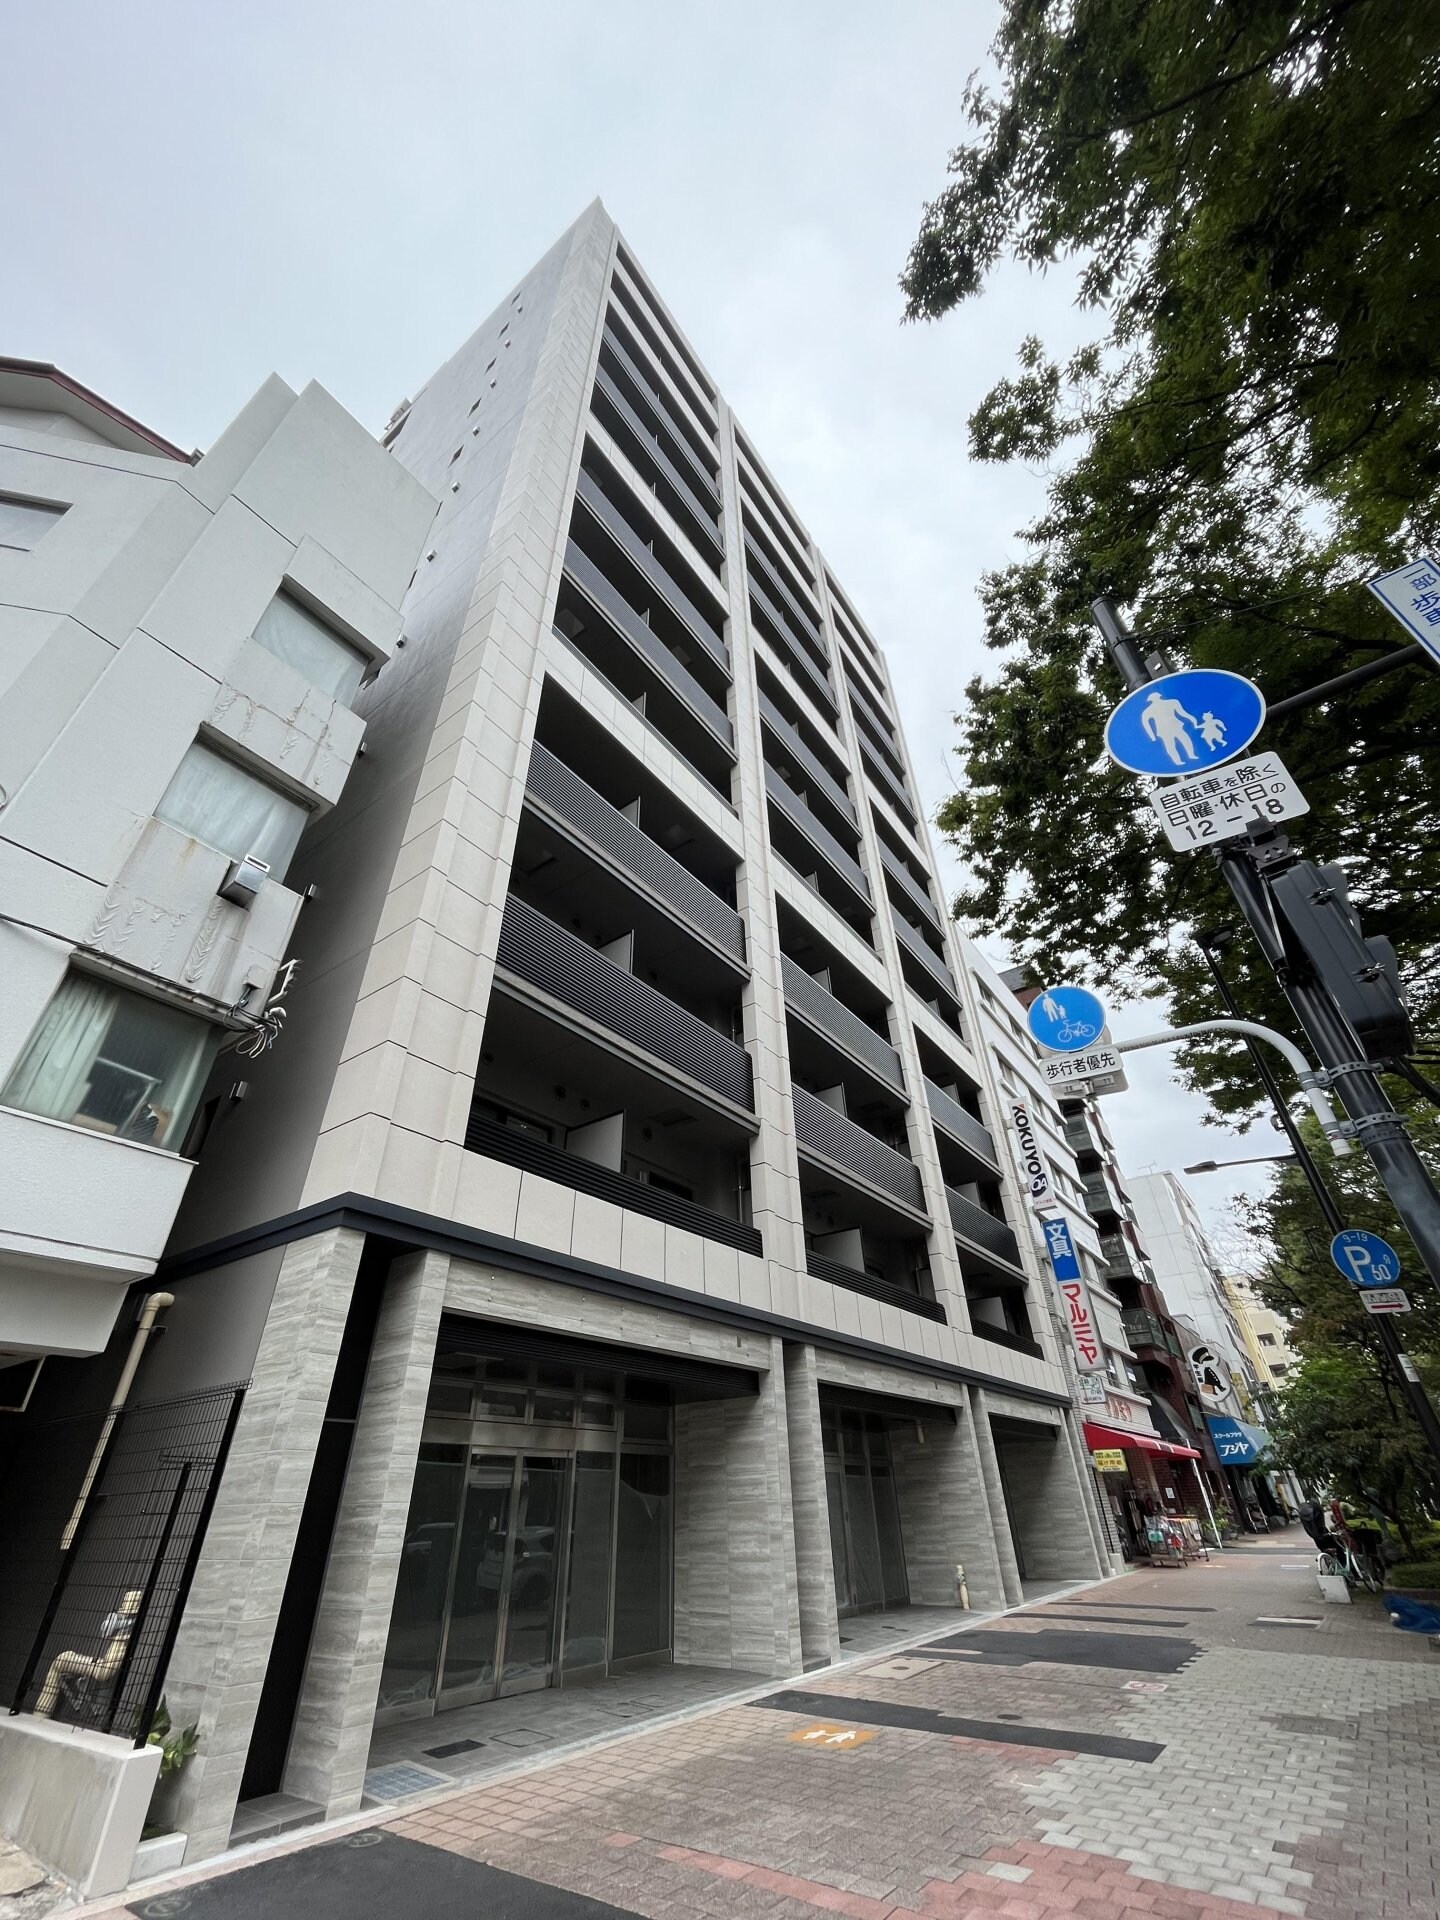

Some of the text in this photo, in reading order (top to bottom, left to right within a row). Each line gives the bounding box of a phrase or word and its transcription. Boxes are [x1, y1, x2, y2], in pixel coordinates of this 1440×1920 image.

[1159, 763, 1279, 809] 自転車を除く
[1046, 1052, 1116, 1079] 歩行者優先
[1012, 1104, 1042, 1175] KOKUYO
[1342, 1231, 1368, 1243] 9-19
[1343, 1245, 1372, 1282] P
[1062, 1283, 1098, 1365] マルミヤ
[1219, 1441, 1250, 1457] フジヤ
